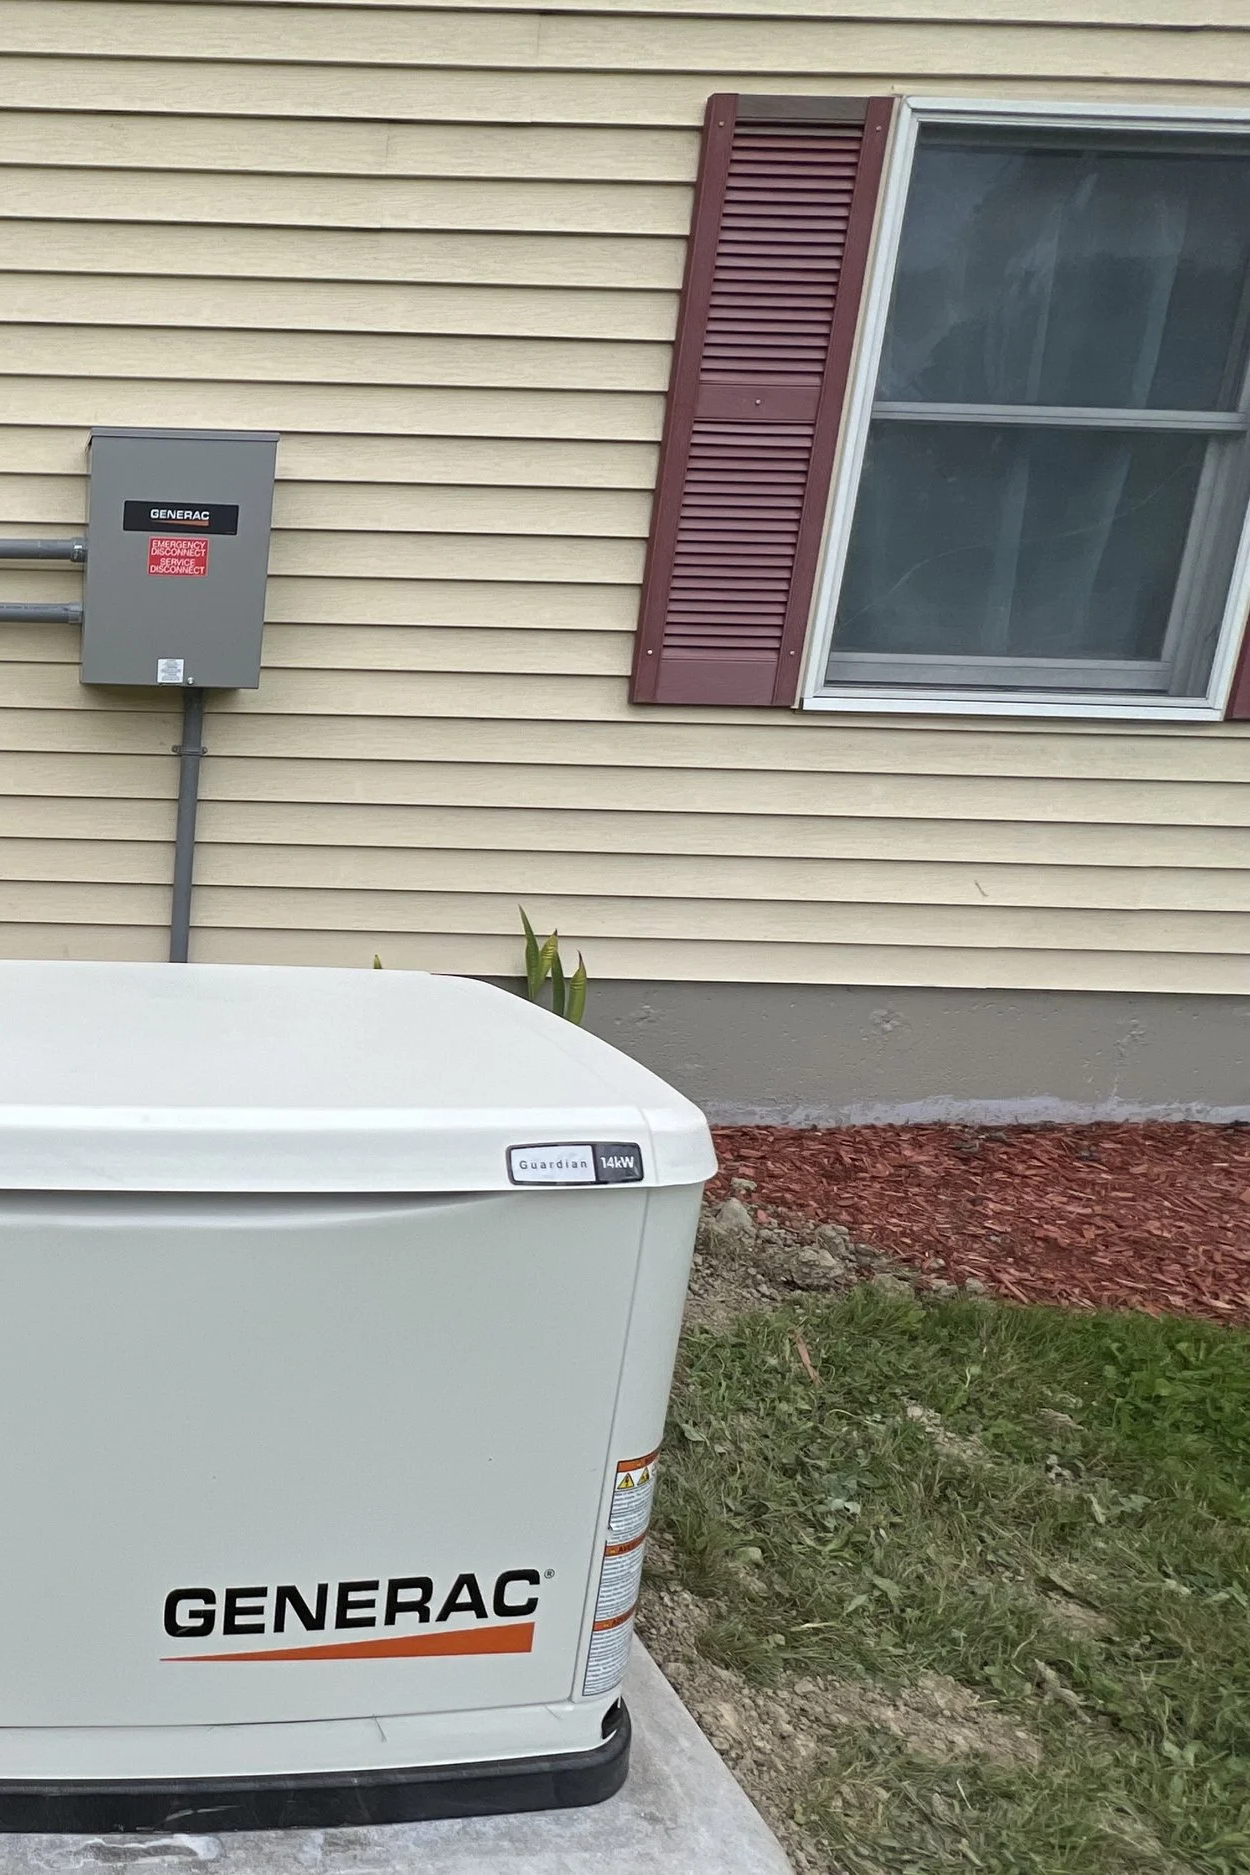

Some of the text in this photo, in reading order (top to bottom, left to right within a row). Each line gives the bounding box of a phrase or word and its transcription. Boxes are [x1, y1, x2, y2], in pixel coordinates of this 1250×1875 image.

[150, 508, 210, 521] GENERAC
[152, 539, 206, 549] EMERGENCY
[151, 547, 206, 557] DISCONNECT
[160, 557, 196, 567] SERVICE
[150, 565, 205, 575] DISCONNECT
[519, 1156, 635, 1170] Guardian 14kW
[164, 1569, 541, 1638] GENERAC
